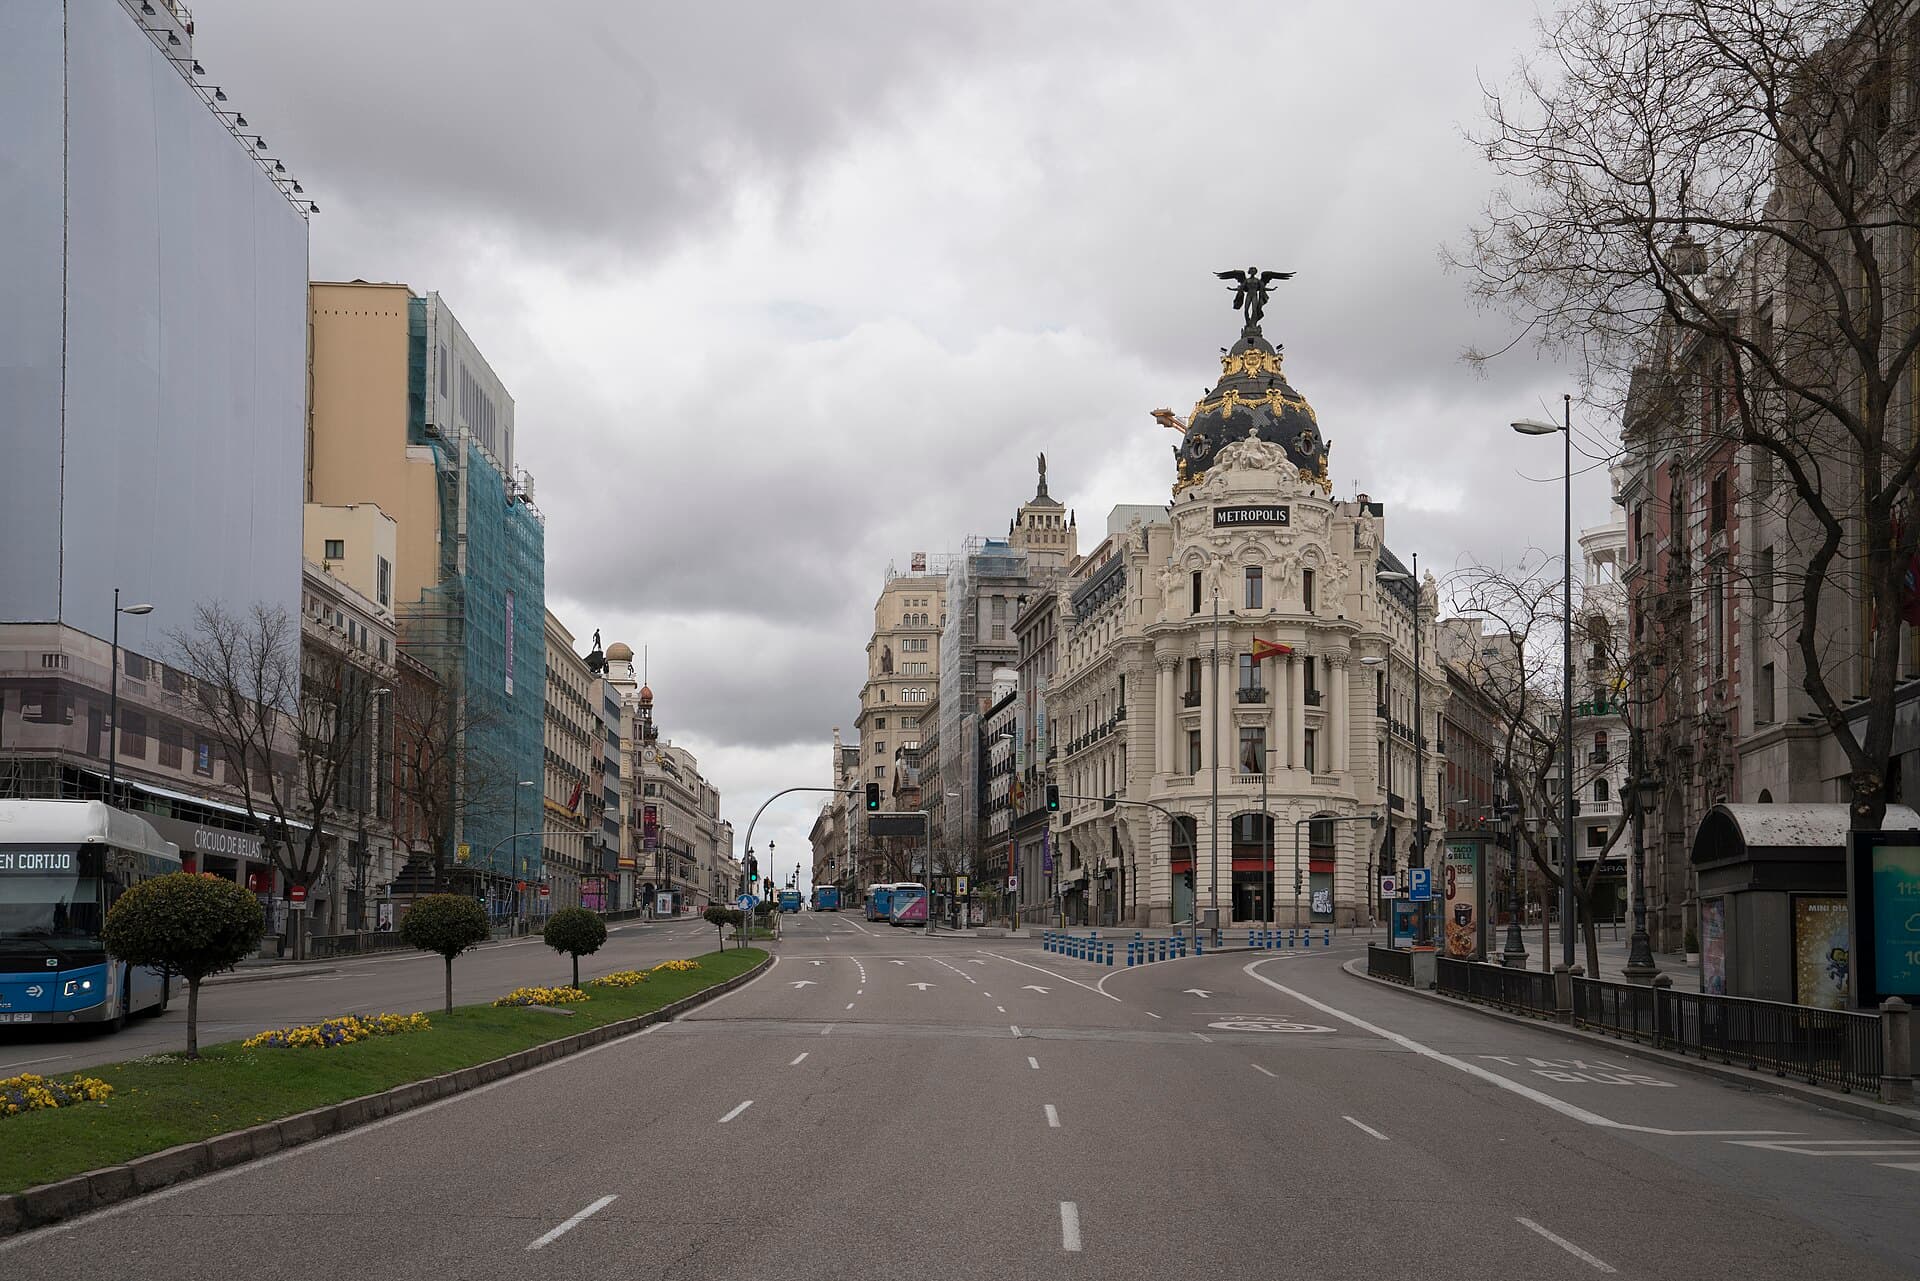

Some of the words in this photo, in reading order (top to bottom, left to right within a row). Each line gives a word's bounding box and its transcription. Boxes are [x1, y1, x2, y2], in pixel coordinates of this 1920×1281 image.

[1217, 510, 1287, 523] METROPOLIS
[194, 825, 226, 852] CÍRCULO
[227, 836, 237, 854] DE
[237, 837, 261, 859] BELLAS
[18, 853, 71, 869] CORTIJO
[1411, 870, 1426, 891] P
[1808, 903, 1830, 912] MINI
[1477, 1055, 1632, 1072] TAXI
[1530, 1069, 1681, 1088] BUS
